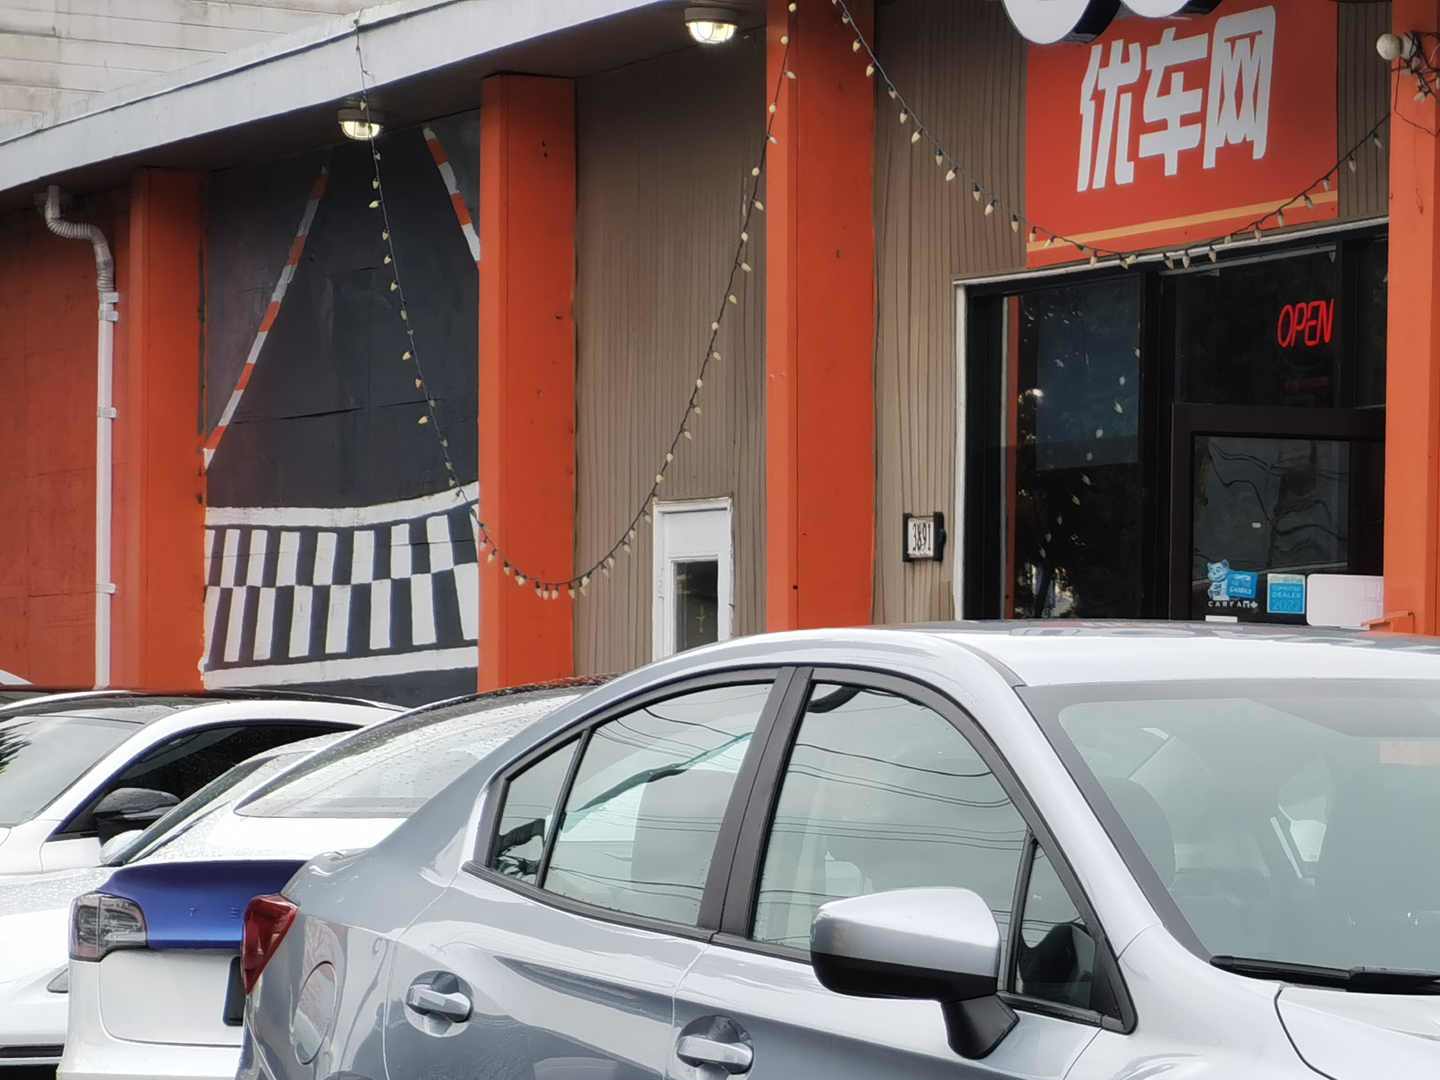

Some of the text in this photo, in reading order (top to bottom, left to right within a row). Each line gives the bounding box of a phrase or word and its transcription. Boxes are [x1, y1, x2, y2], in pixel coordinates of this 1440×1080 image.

[1076, 5, 1277, 193] 优车网
[1277, 298, 1334, 348] OPEN
